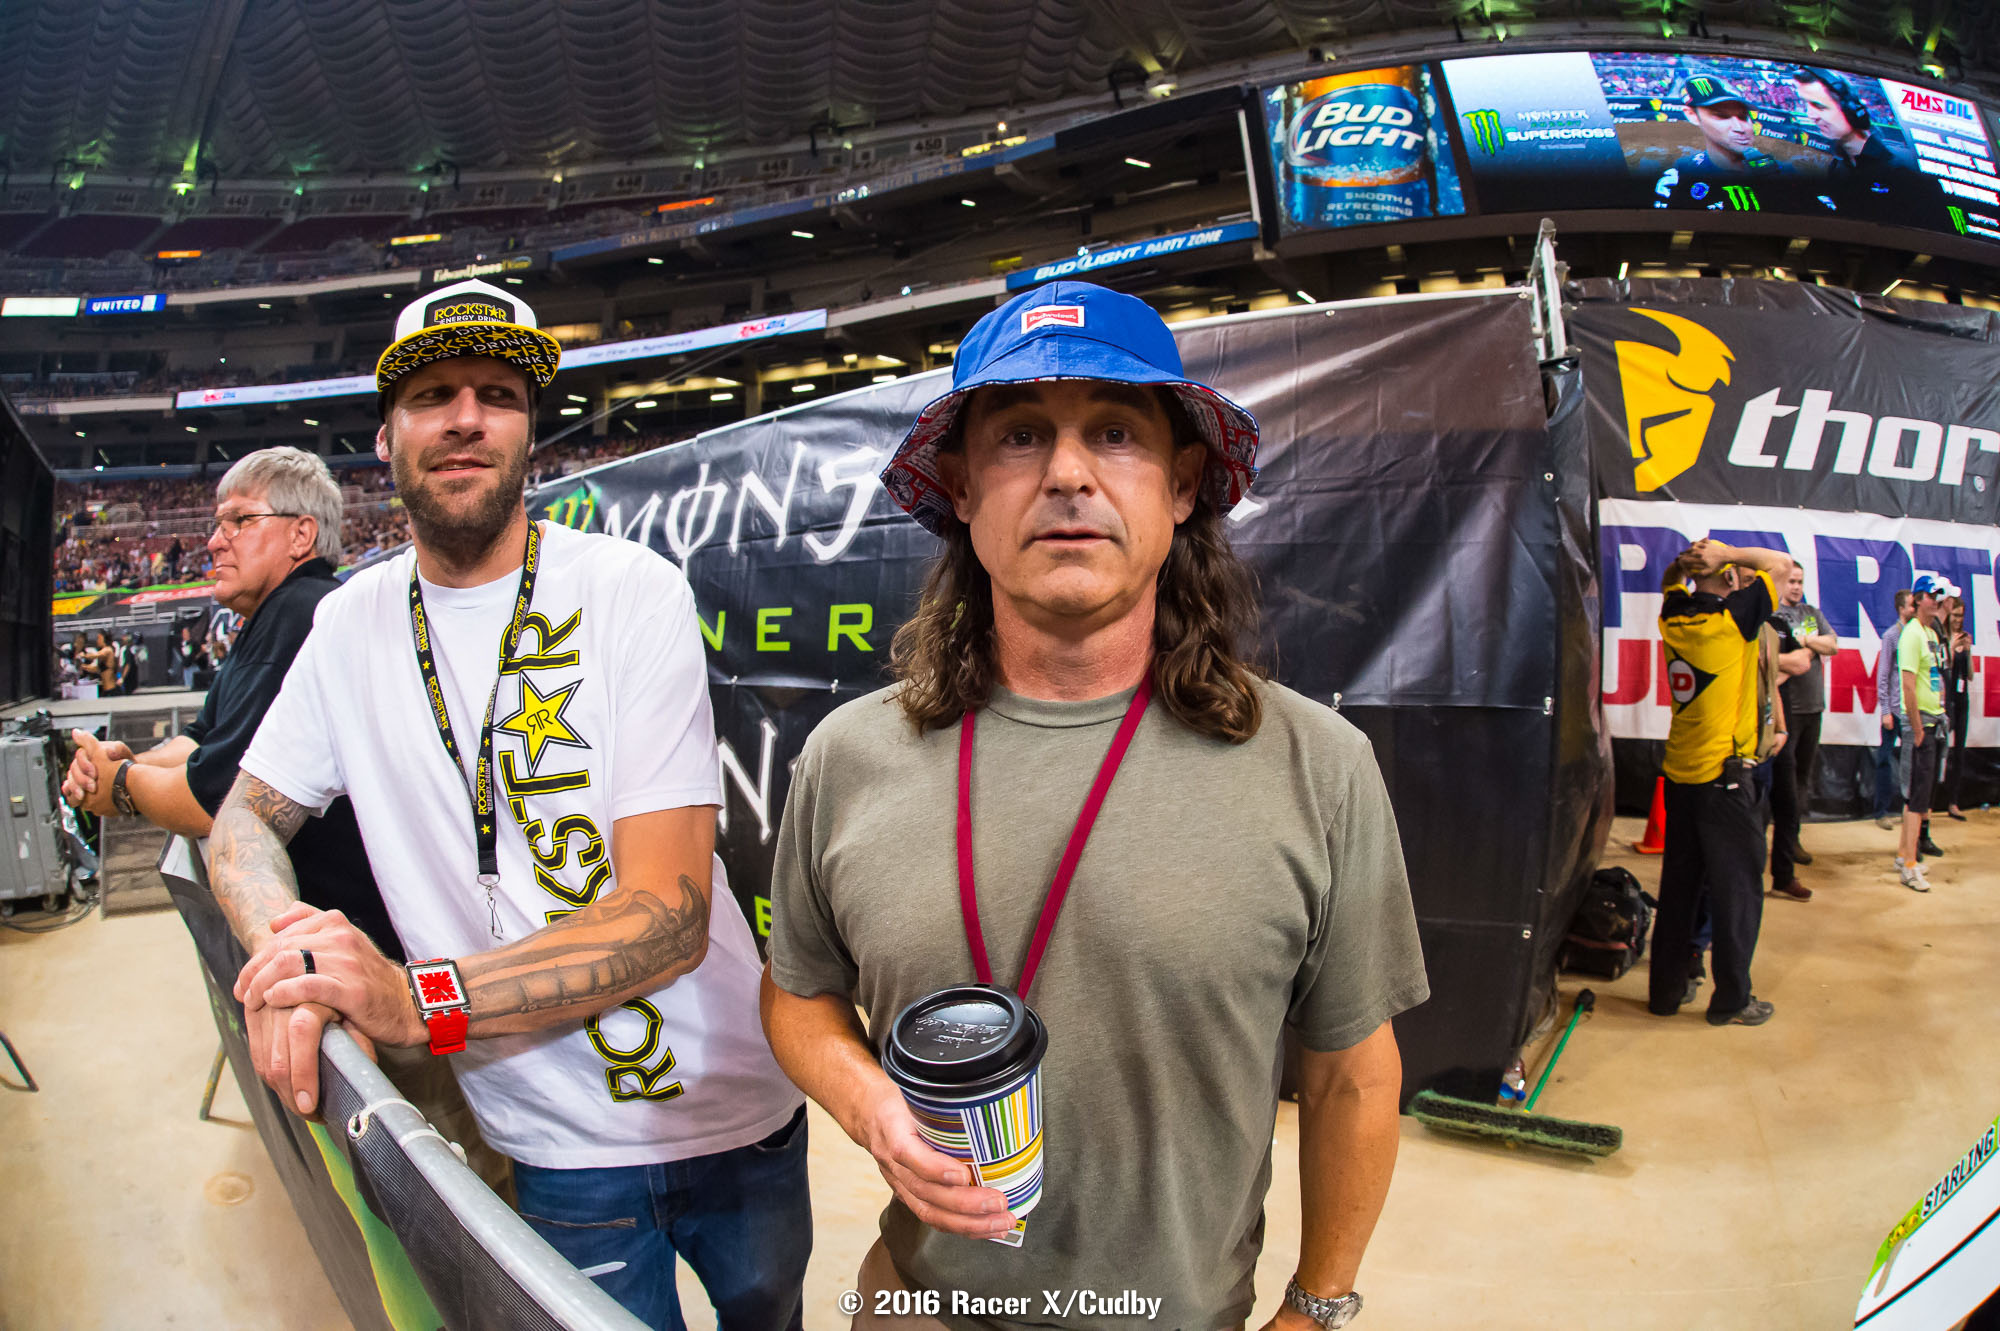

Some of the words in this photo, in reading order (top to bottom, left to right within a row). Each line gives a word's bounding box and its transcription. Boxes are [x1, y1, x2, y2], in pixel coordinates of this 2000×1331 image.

[1312, 102, 1413, 127] BUD
[1901, 89, 1973, 121] AMSOIL
[1295, 126, 1424, 155] LIGHT
[1505, 127, 1616, 142] SUPERCROSS
[1327, 202, 1413, 217] REFRESHING
[1345, 192, 1403, 204] SMOOTH
[1034, 262, 1079, 280] BUD
[1085, 246, 1142, 270] LIGHT
[1144, 238, 1184, 255] PARTY
[1186, 229, 1223, 247] ZONE
[92, 299, 141, 312] UNITED
[434, 303, 507, 322] ROCKSTAR
[440, 315, 475, 324] ENERGY
[1728, 386, 2000, 487] thor
[604, 442, 883, 580] MONS
[526, 530, 538, 573] ROCKSTAR
[413, 602, 430, 652] ROCKSTAR
[510, 595, 527, 647] ROCKSTAR
[428, 676, 450, 730] ROCKSTAR
[477, 757, 488, 815] ROCKSTAR
[498, 608, 686, 1102] ROKSTAR
[1922, 1127, 1994, 1217] STARLING
